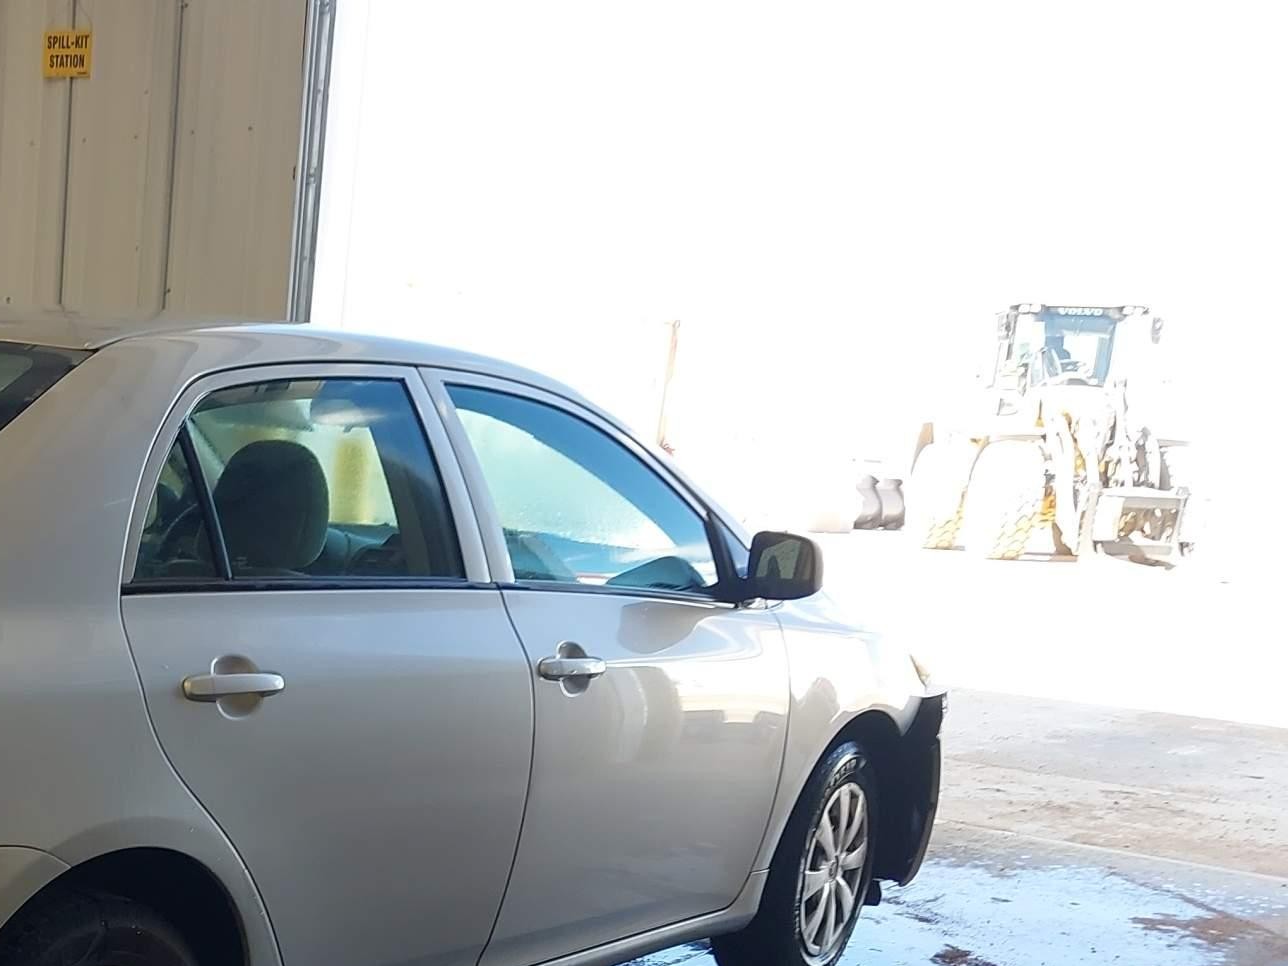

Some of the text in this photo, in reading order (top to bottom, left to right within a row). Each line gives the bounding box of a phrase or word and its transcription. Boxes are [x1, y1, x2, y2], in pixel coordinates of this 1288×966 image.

[47, 34, 89, 49] SPILL-KIT
[49, 54, 85, 68] STATION
[1057, 307, 1103, 316] VOLVO
